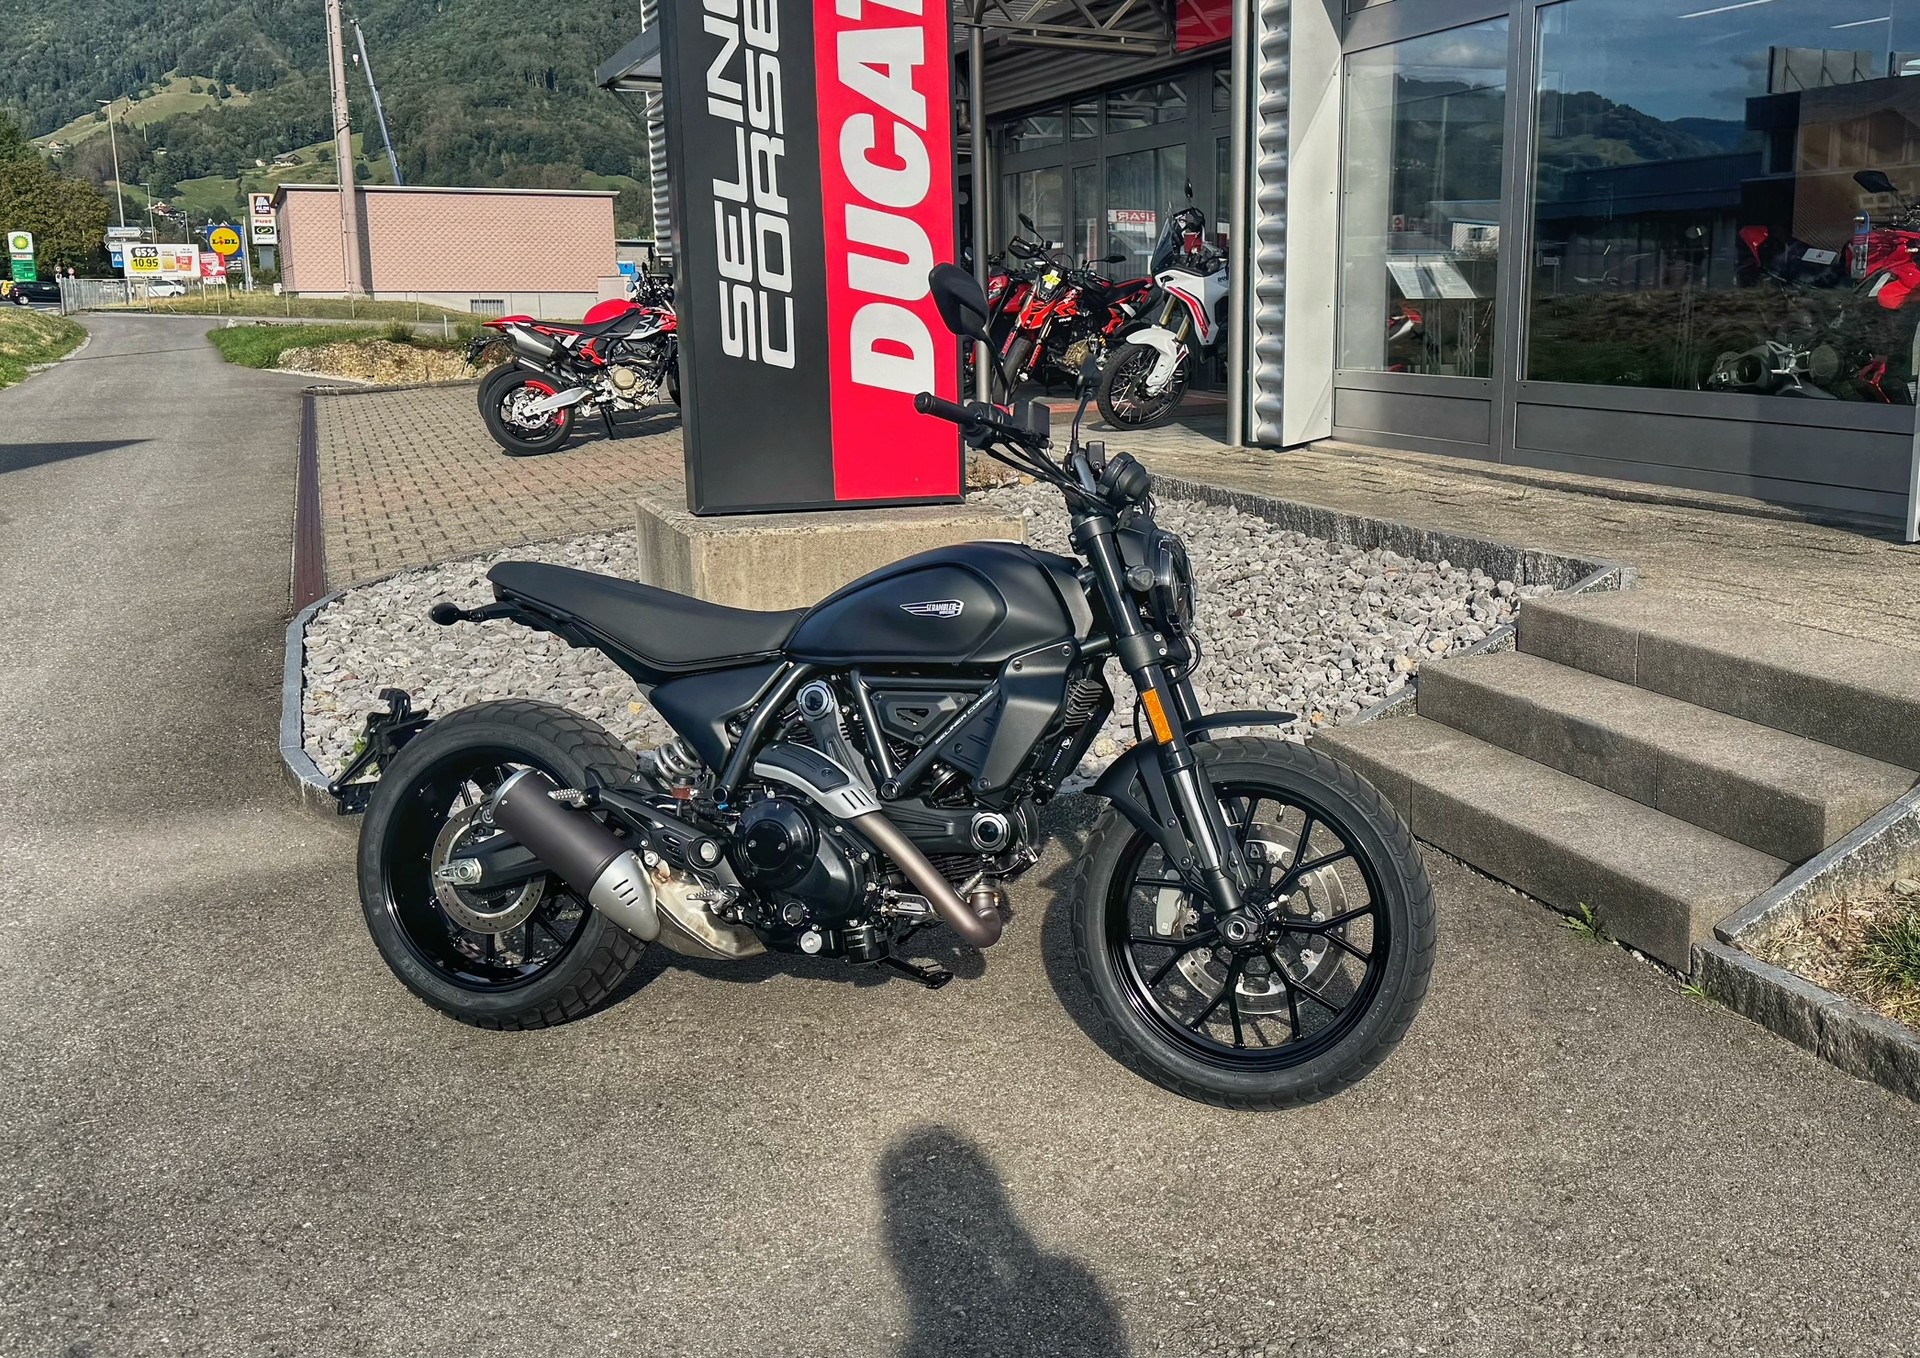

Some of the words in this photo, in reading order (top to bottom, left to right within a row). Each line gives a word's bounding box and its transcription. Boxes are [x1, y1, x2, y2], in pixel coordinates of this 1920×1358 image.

[703, 0, 758, 362] SELIN
[743, 0, 796, 369] CORSE
[134, 247, 156, 257] 65%
[133, 258, 159, 268] 10.95
[202, 275, 226, 285] NEIN
[926, 603, 957, 612] SCRAMBLER
